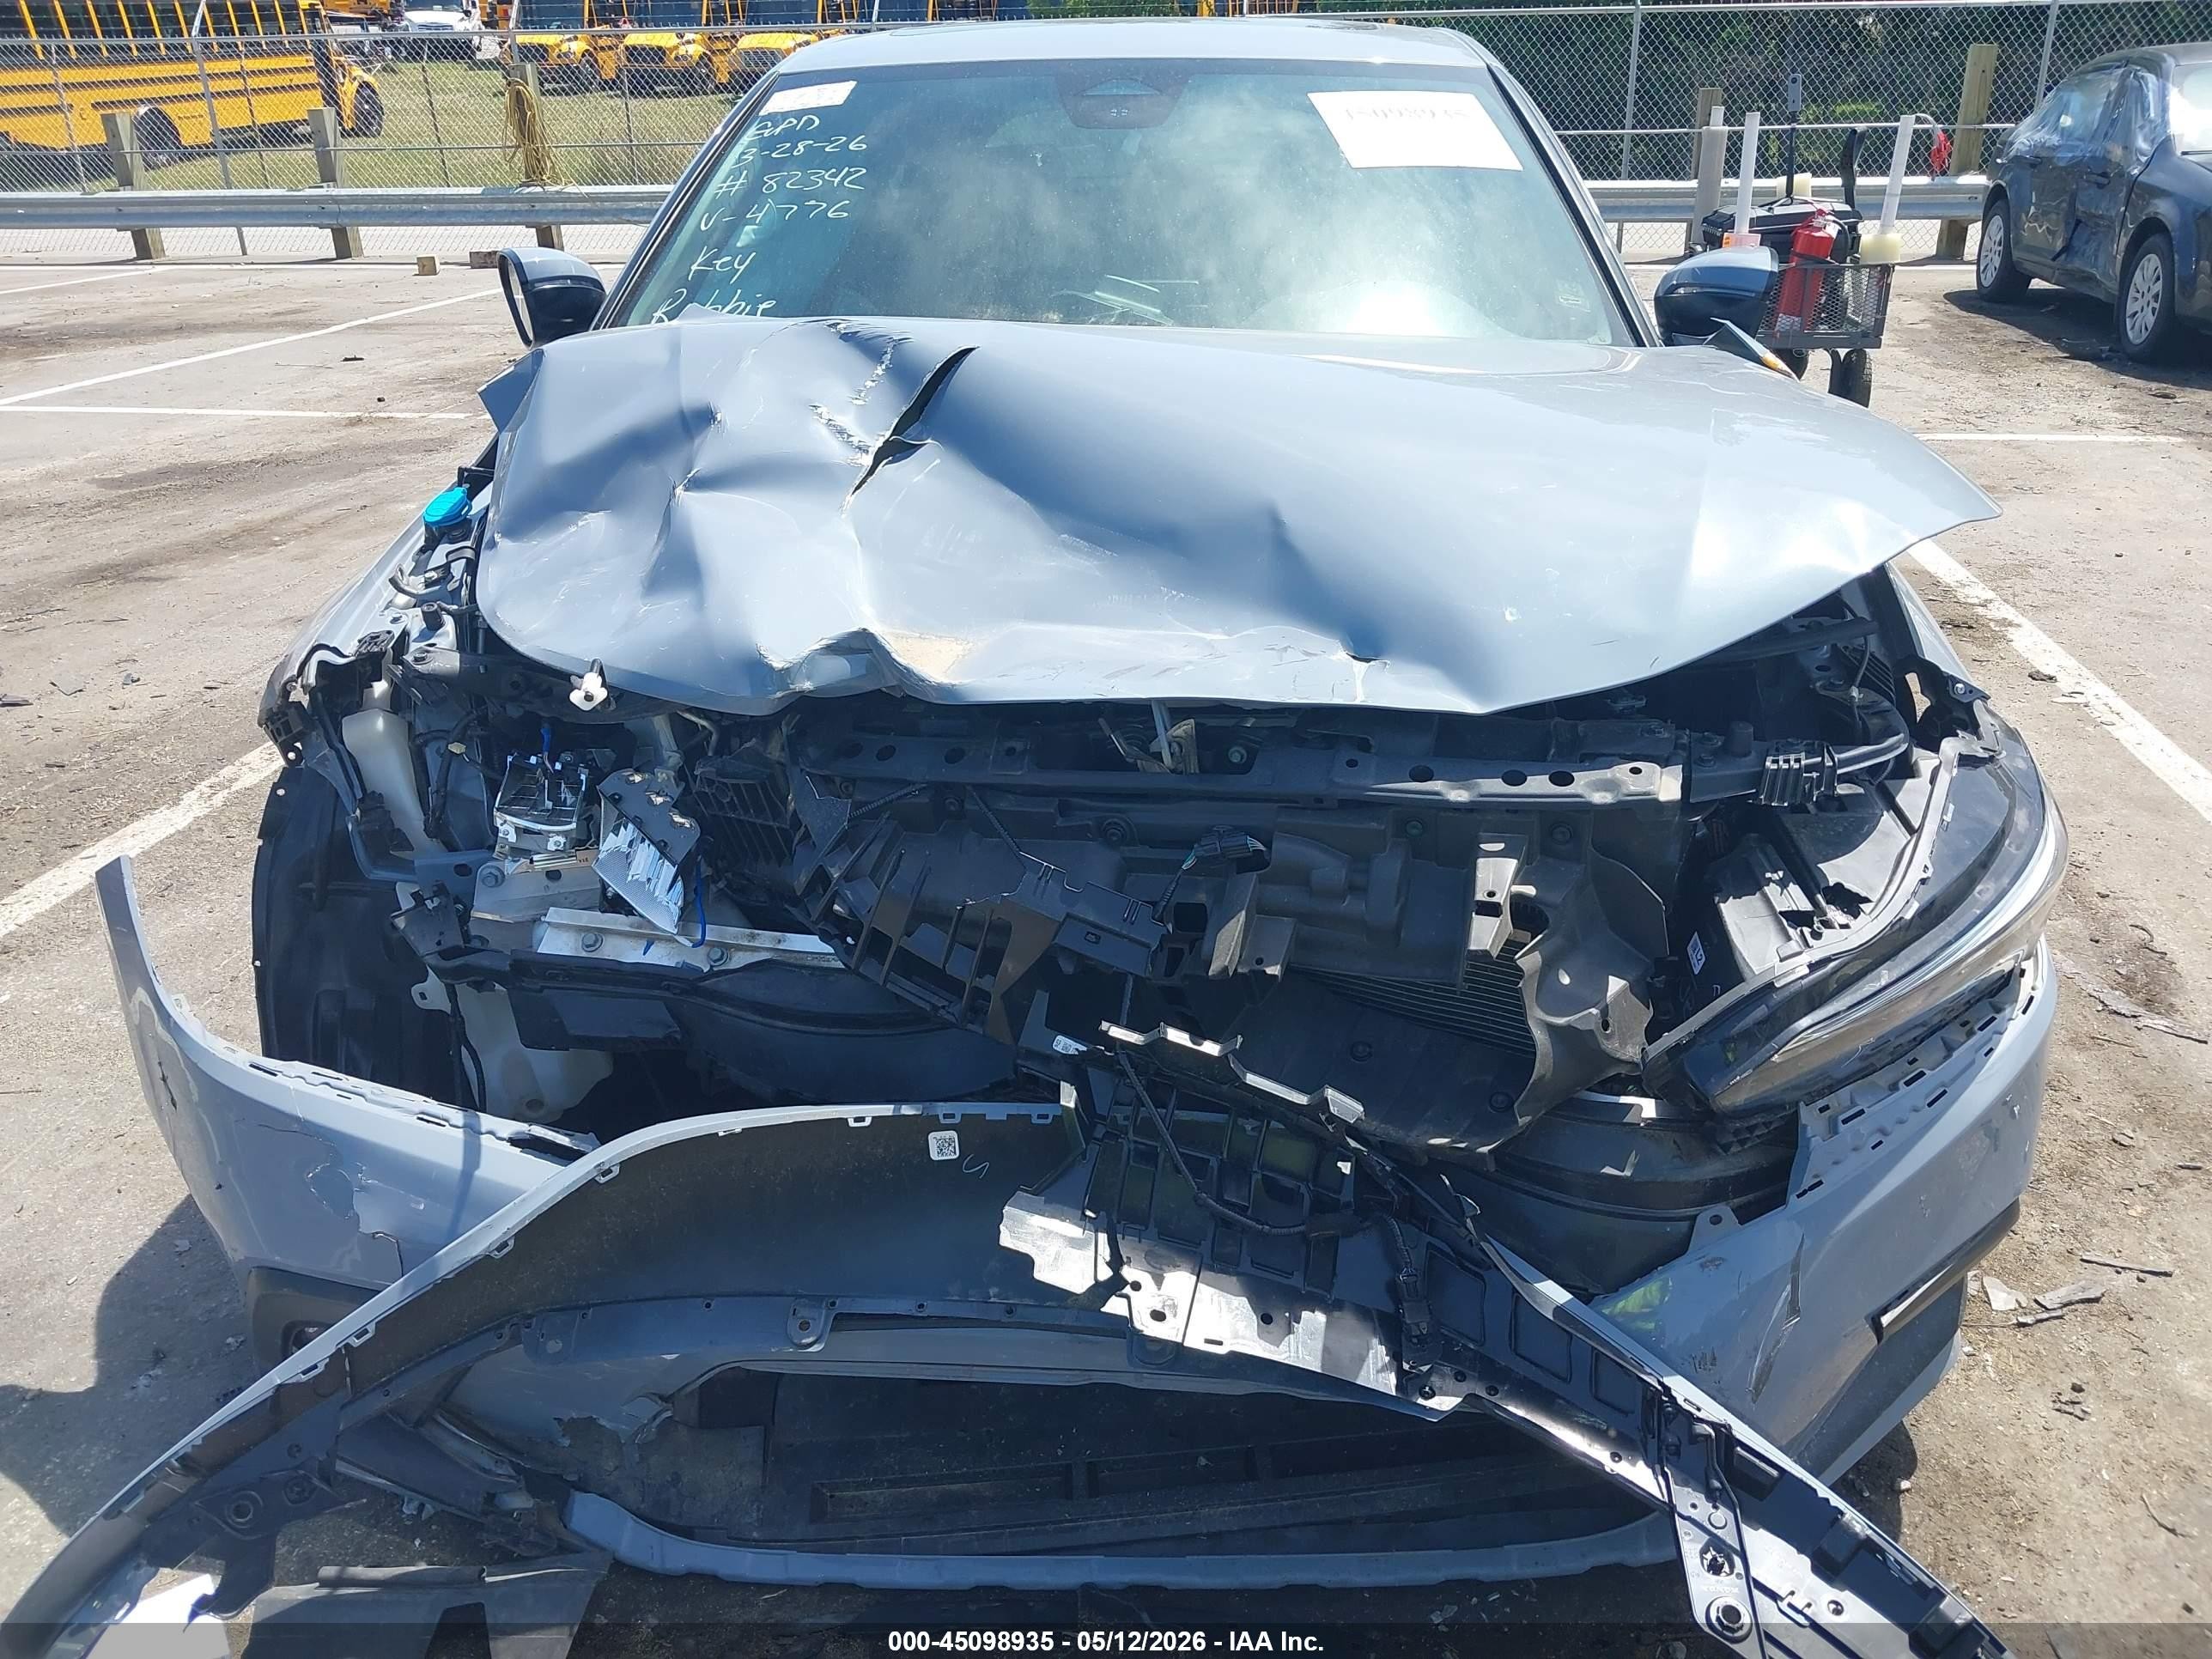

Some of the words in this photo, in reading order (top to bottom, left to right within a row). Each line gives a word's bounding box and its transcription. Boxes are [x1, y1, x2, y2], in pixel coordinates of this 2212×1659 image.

[731, 135, 868, 168] 3-28-26
[762, 167, 867, 194] 82342
[688, 246, 757, 284] Key
